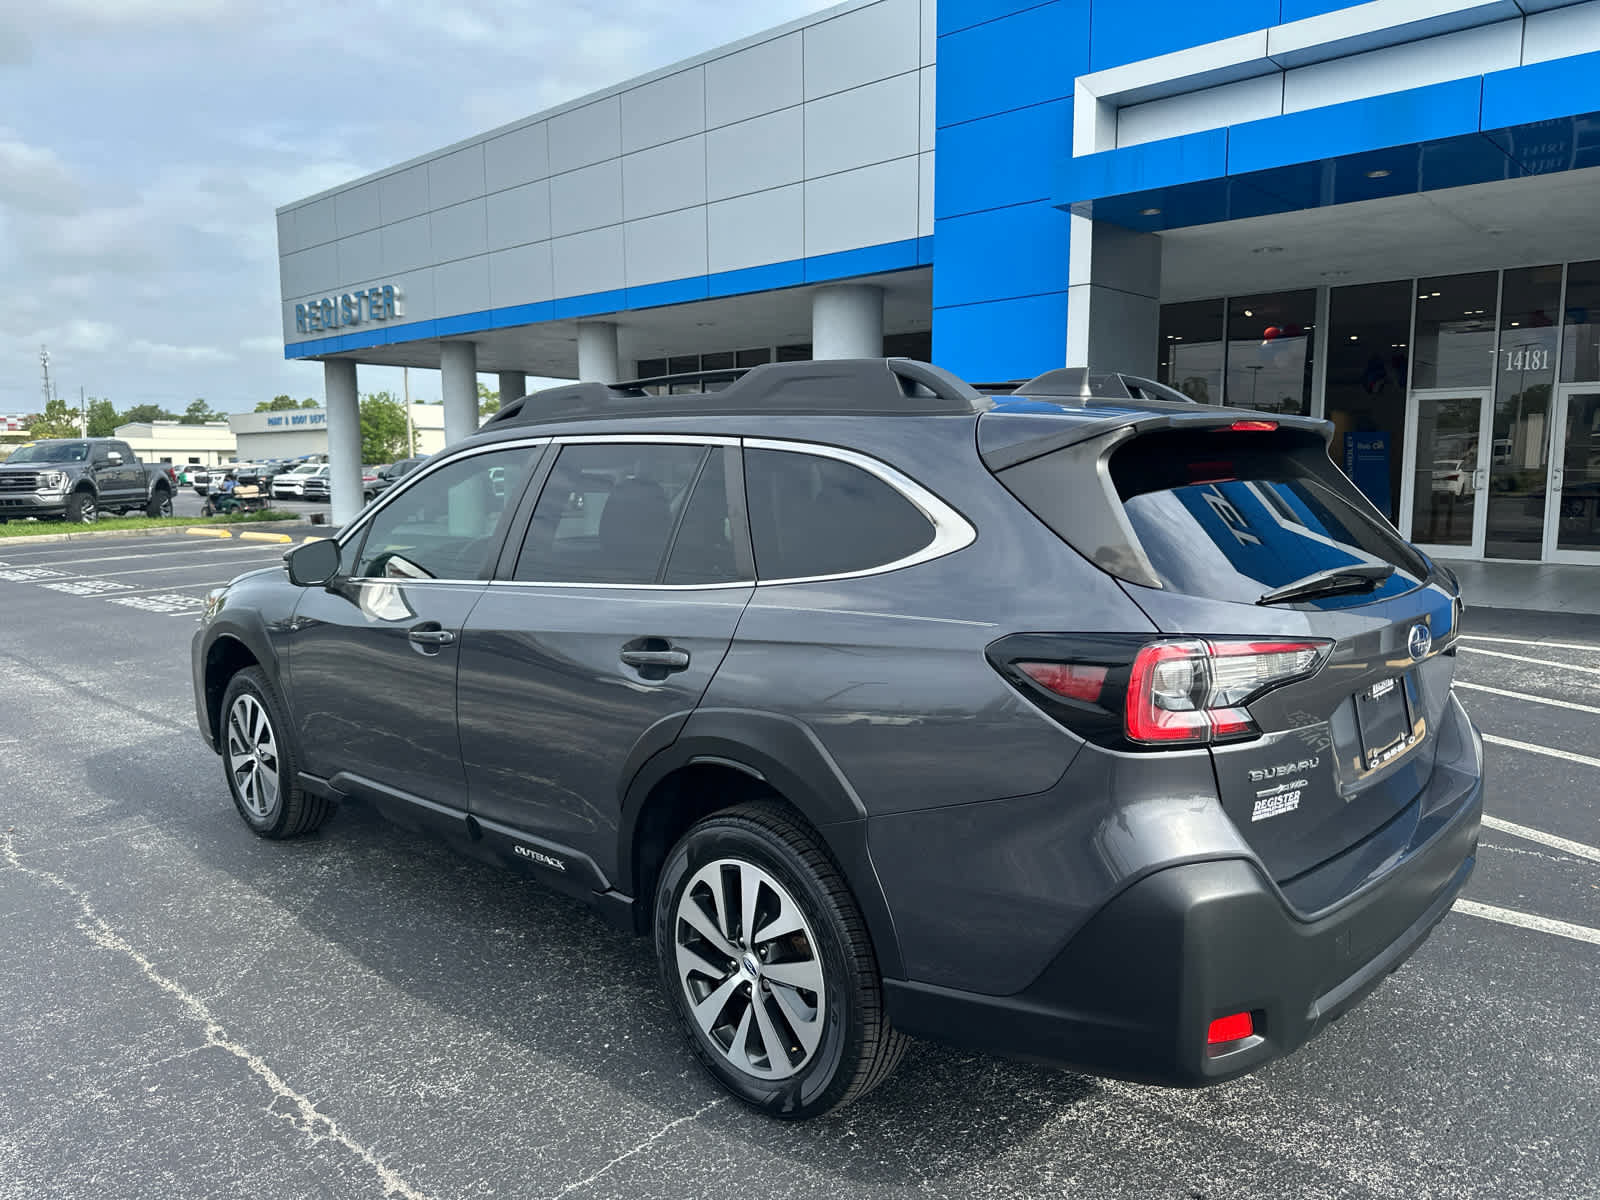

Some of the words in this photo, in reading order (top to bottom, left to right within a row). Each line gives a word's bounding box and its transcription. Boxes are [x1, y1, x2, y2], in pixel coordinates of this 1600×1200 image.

[296, 285, 398, 333] REGISTER
[1504, 350, 1549, 371] 14181
[1248, 757, 1319, 782] SUBARU
[1254, 790, 1301, 811] REGISTER
[514, 845, 566, 870] OUTBACK
